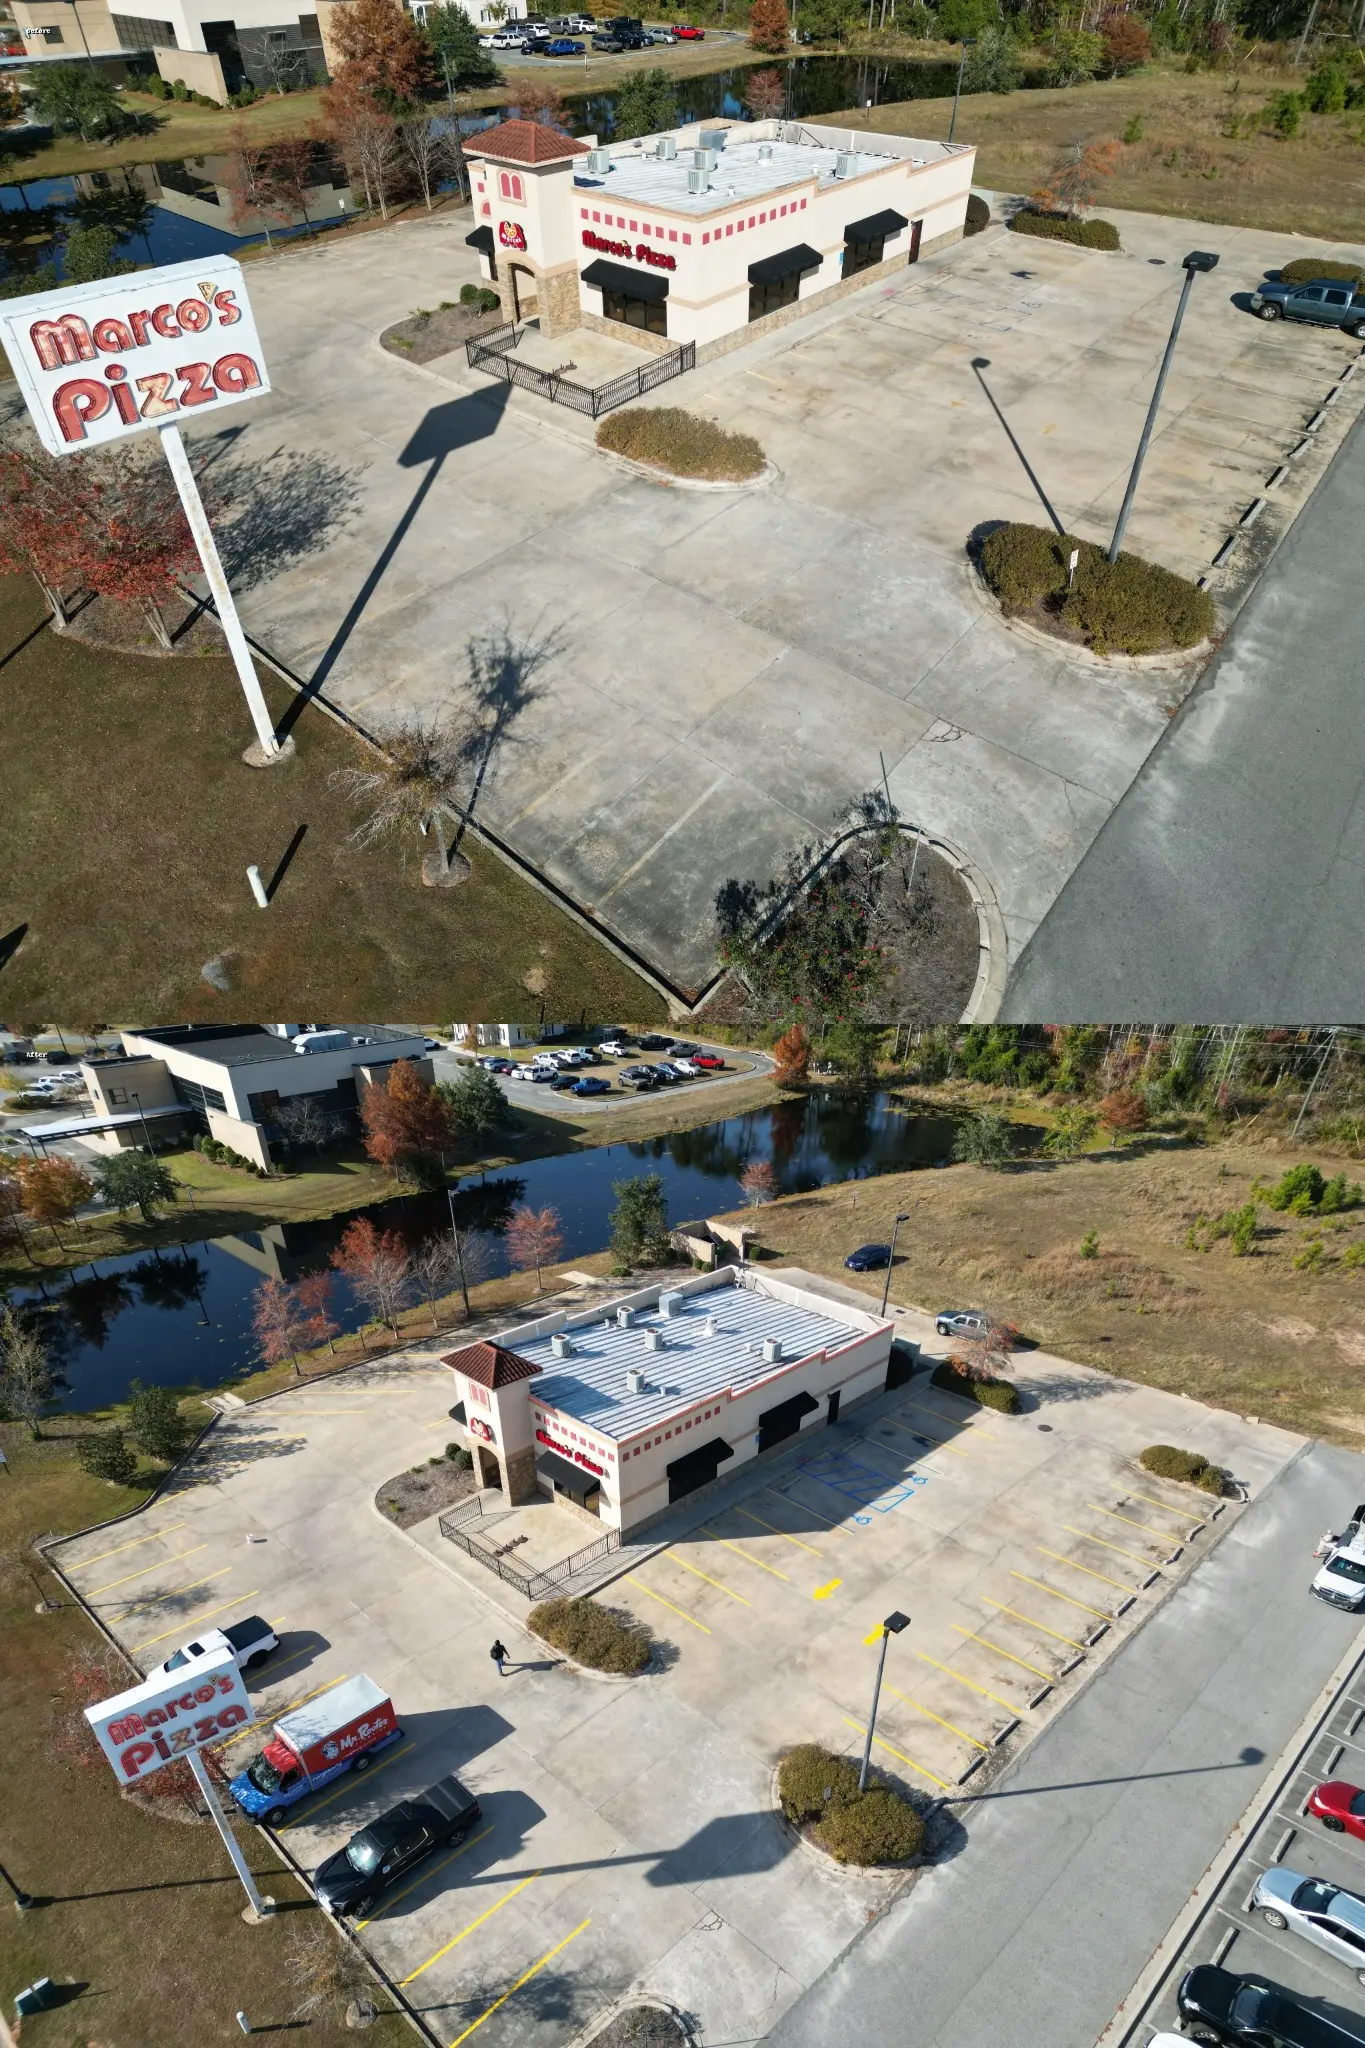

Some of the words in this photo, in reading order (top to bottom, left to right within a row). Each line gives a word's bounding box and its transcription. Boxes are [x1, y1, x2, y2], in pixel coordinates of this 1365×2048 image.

[582, 230, 633, 260] Marco's
[636, 244, 676, 271] Pizza
[29, 282, 241, 371] Marco's
[107, 1674, 235, 1745] Marco's
[357, 1717, 389, 1740] Rooter
